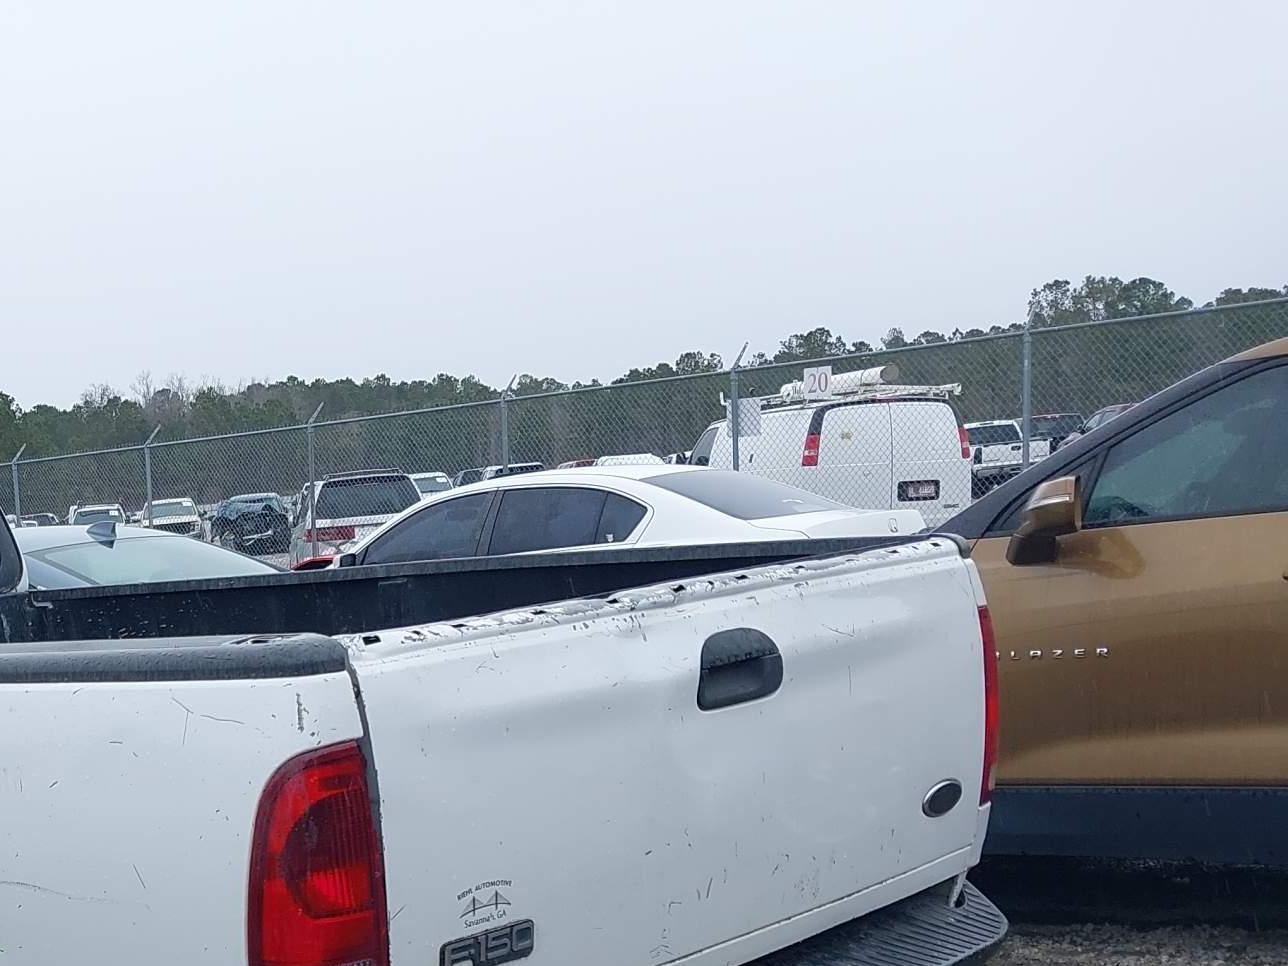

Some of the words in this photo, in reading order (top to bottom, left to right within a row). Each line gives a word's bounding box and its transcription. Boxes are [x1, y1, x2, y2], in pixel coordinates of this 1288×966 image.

[807, 372, 829, 394] 20
[995, 647, 1109, 661] LAZER
[474, 880, 513, 892] AUTOMOTIVE
[497, 909, 507, 919] GA
